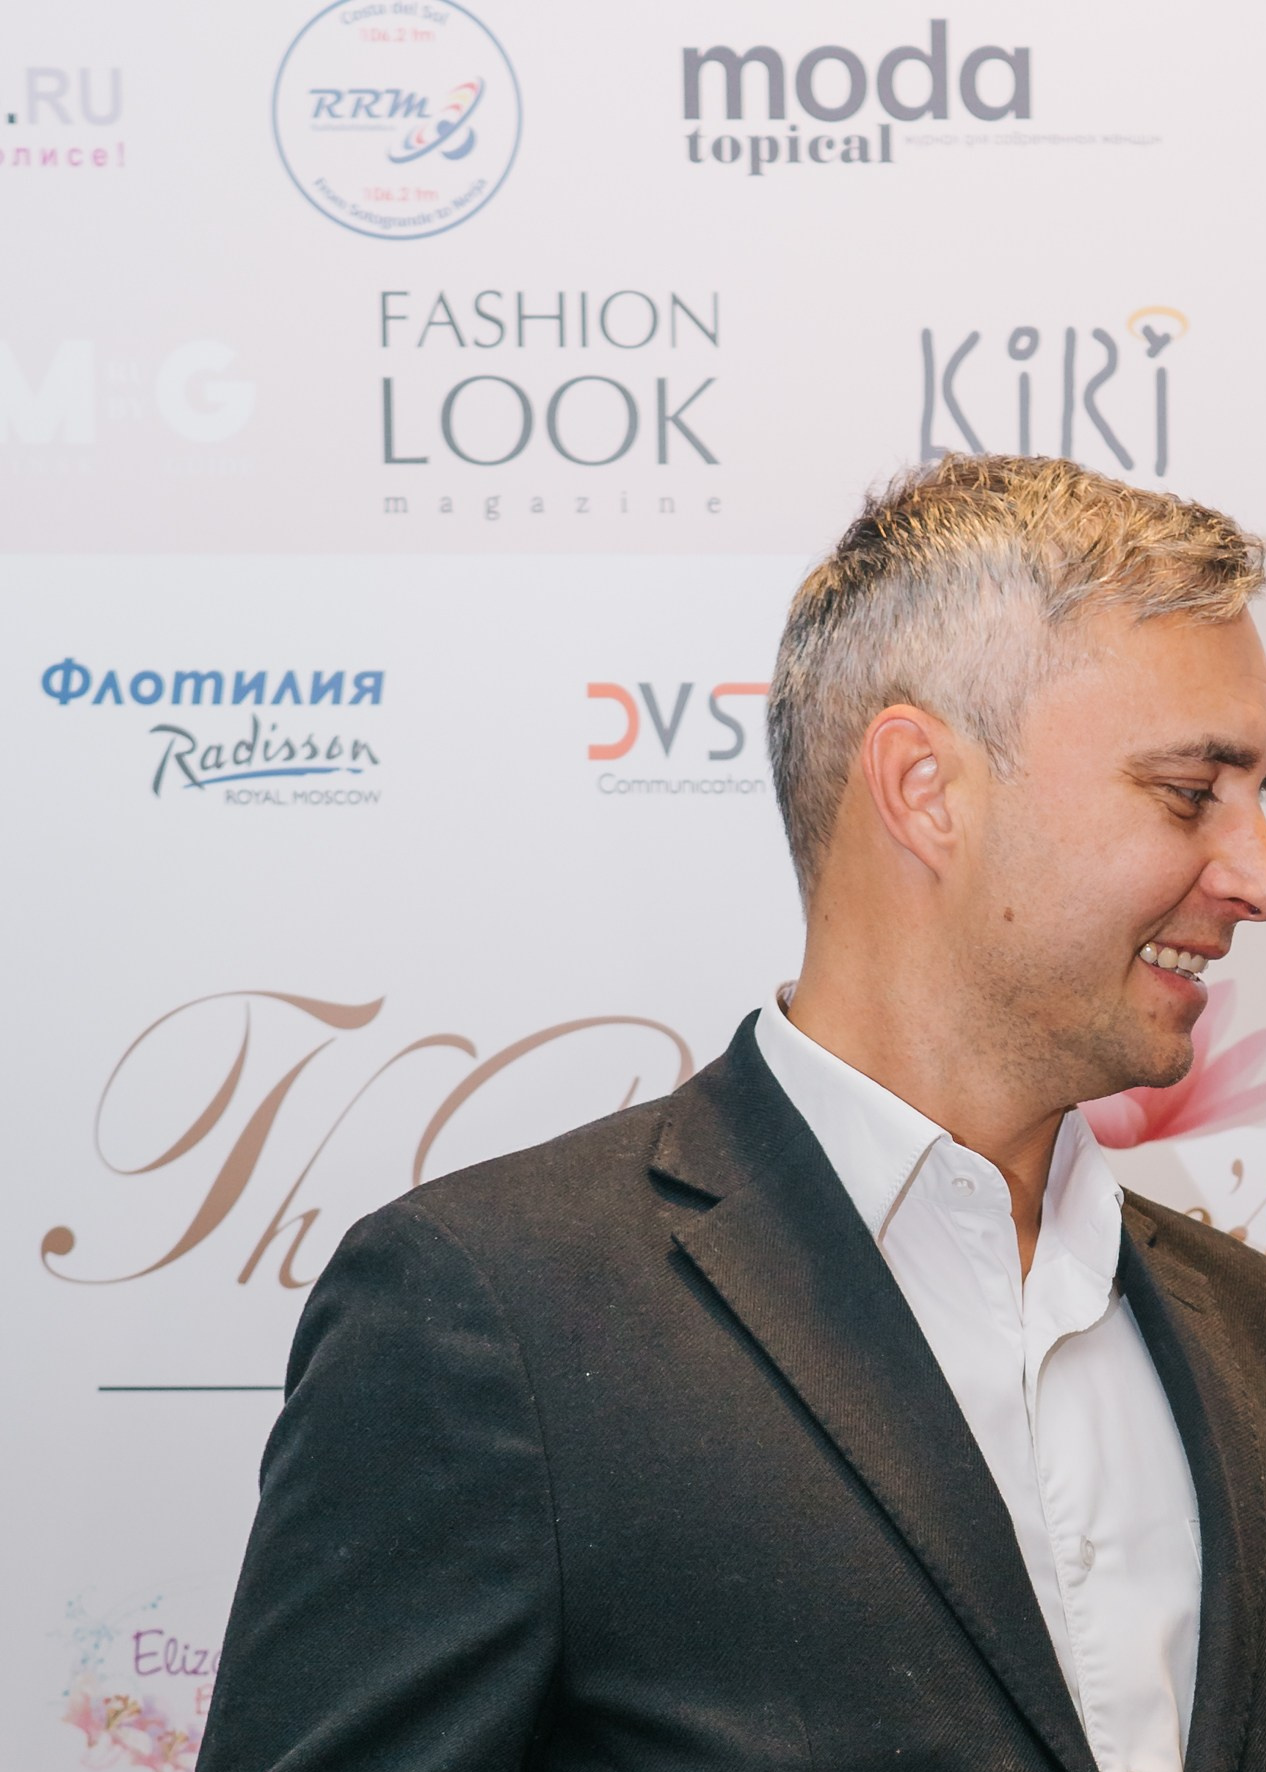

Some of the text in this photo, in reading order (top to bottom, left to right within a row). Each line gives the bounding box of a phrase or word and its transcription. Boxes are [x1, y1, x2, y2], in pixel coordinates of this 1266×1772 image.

[682, 19, 1032, 121] moda
[686, 124, 896, 176] topical
[380, 290, 719, 348] FASHION
[380, 375, 720, 466] LOOK
[383, 492, 721, 521] magazine
[41, 657, 385, 706] Флотилия
[149, 713, 380, 799] Radisson
[225, 789, 382, 806] ROYAL MOSCOW
[598, 772, 767, 795] Communication
[41, 990, 478, 1290] Th
[132, 1628, 220, 1676] Eliz
